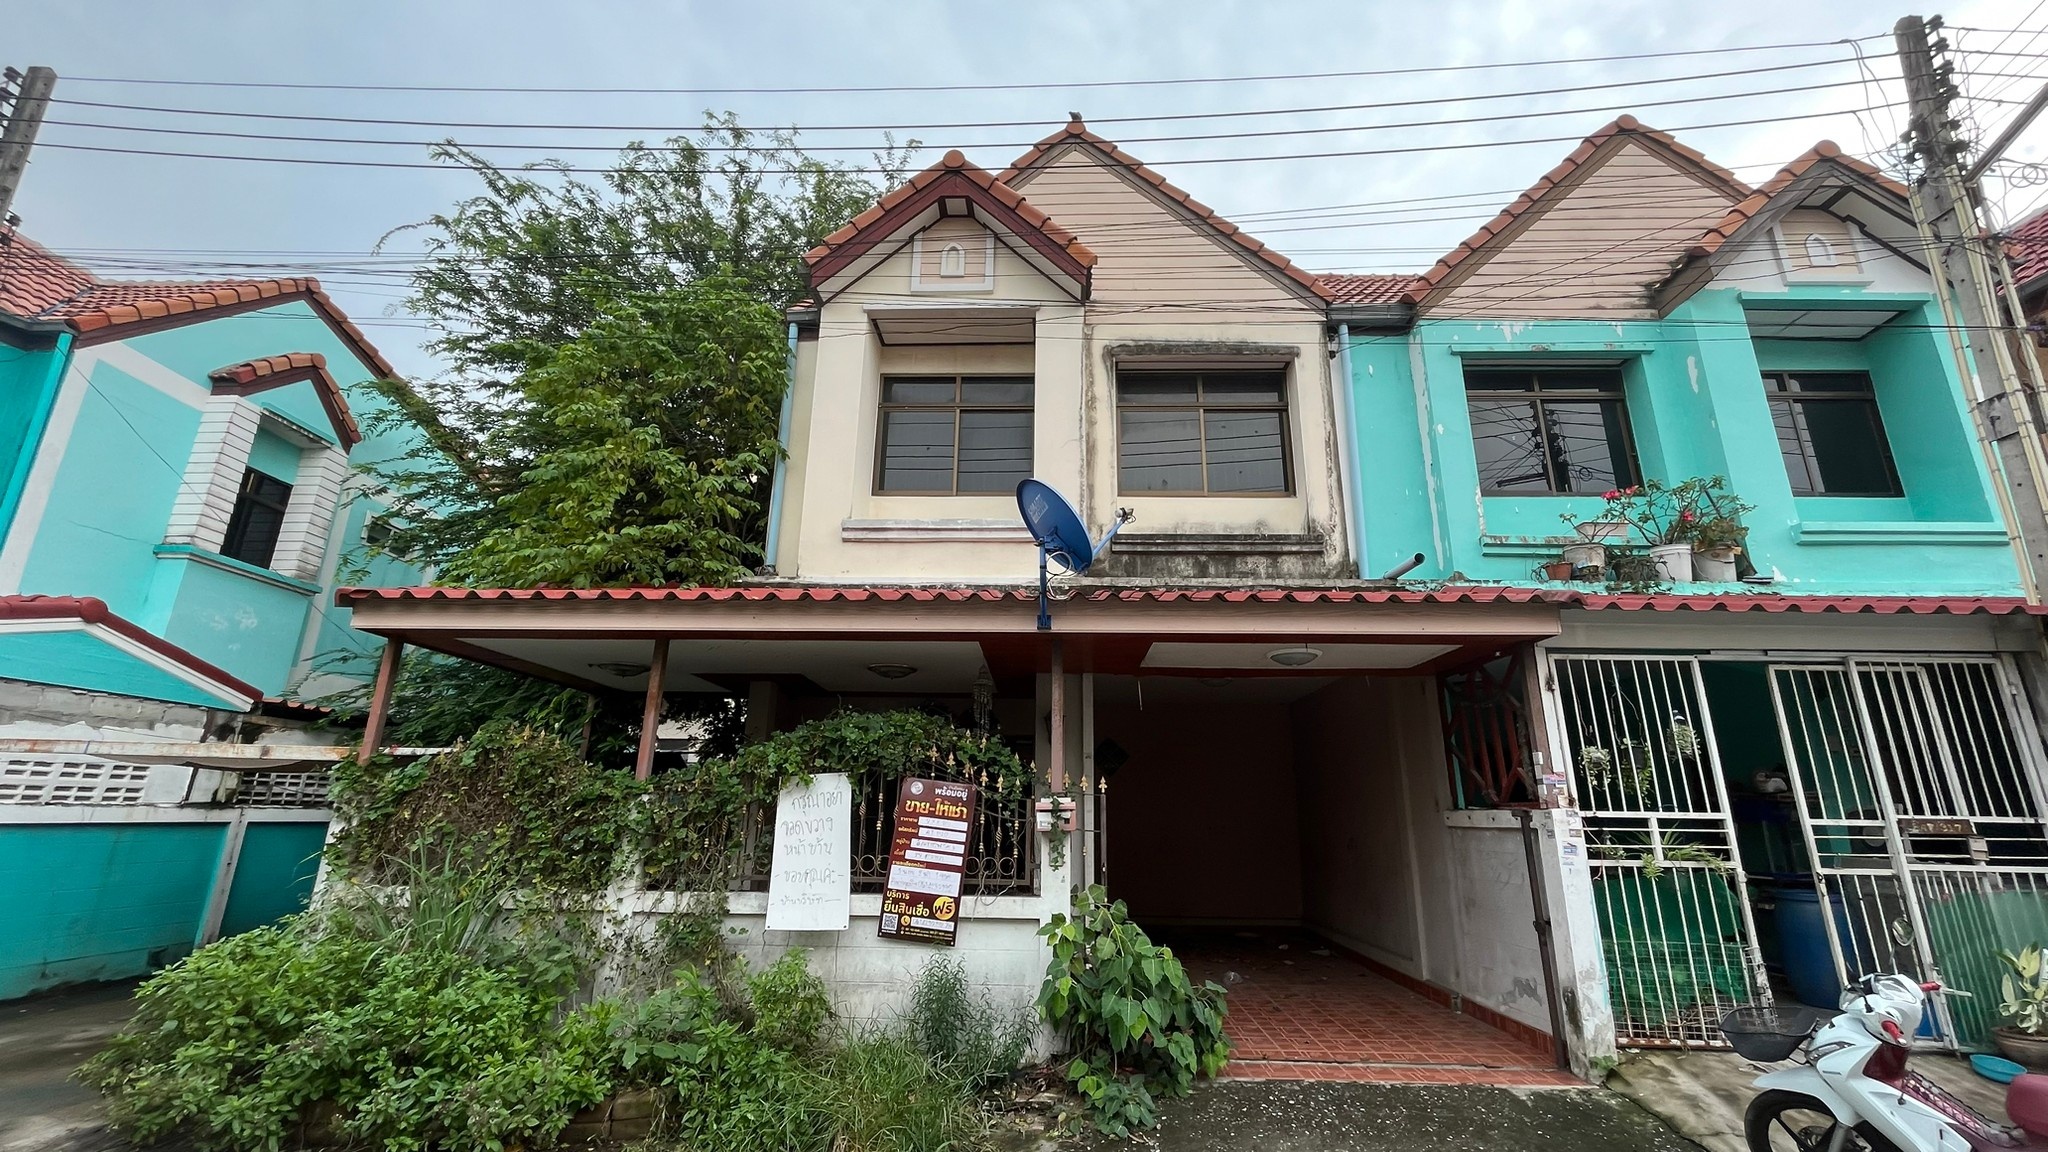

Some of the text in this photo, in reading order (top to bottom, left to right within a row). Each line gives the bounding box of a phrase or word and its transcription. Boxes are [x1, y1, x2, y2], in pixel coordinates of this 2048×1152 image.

[935, 785, 968, 801] พร้อมอยู่
[905, 798, 968, 819] ขาย-ให้เช่า
[886, 889, 910, 900] บริการ
[884, 898, 930, 917] ยื่นสินเชื่อ
[934, 898, 954, 915] ฟรี
